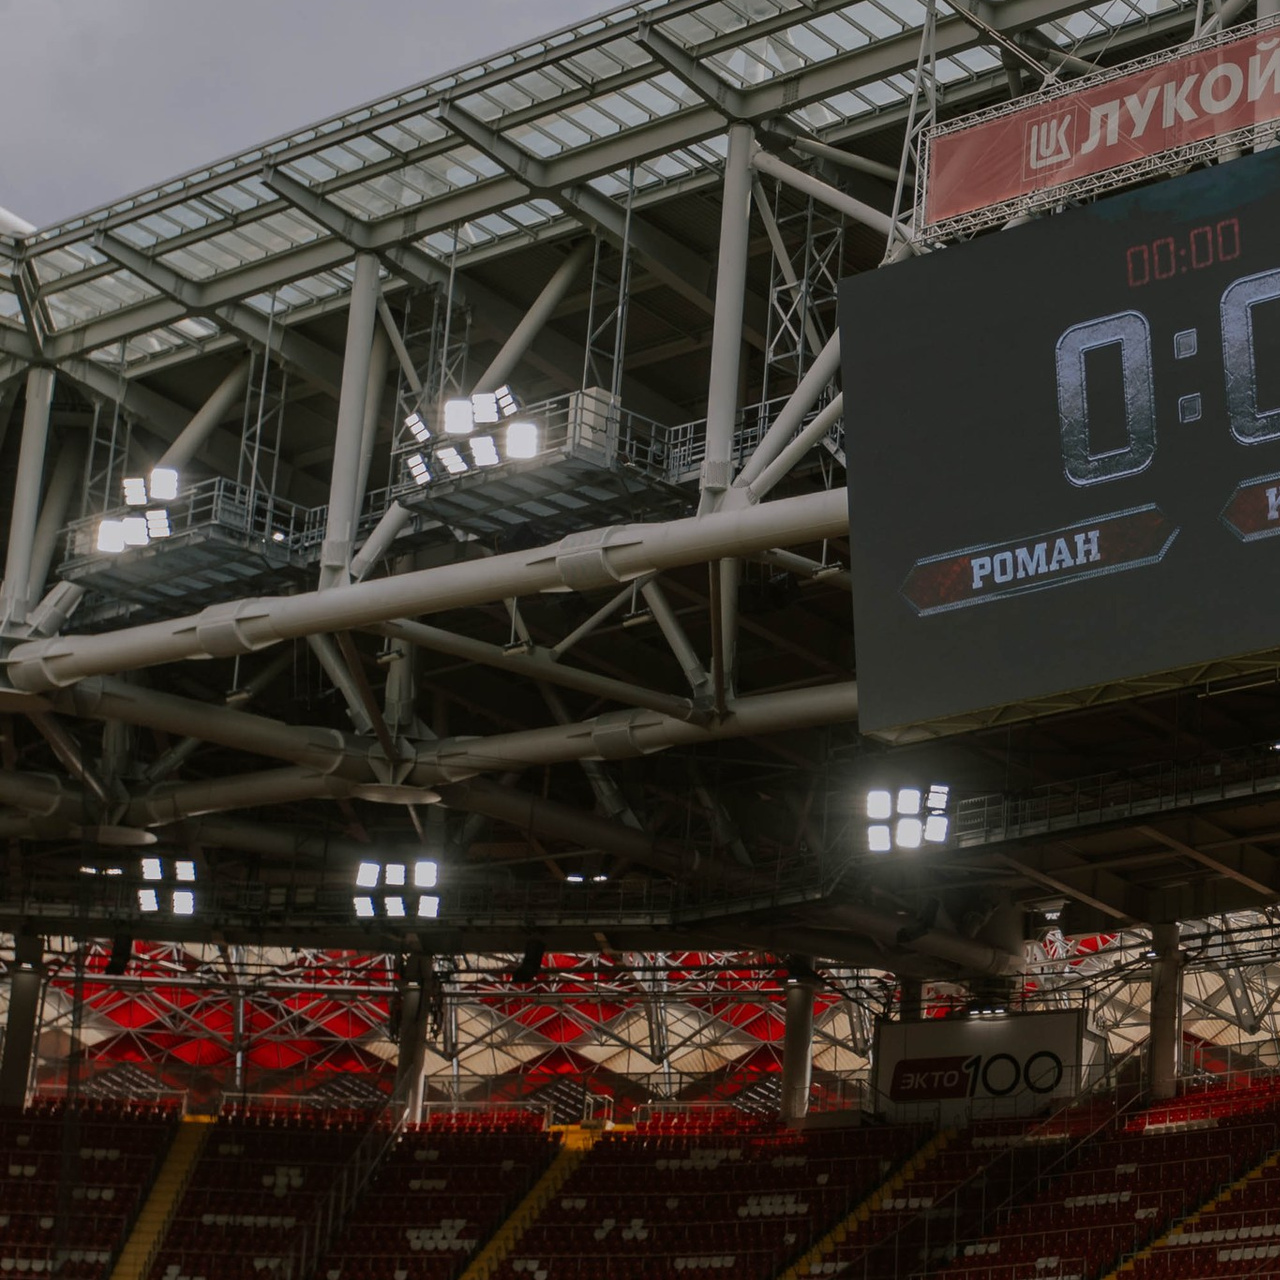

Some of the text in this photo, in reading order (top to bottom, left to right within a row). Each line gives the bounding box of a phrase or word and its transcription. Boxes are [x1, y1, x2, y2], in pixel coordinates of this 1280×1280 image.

[1126, 217, 1242, 287] 00:00
[970, 529, 1101, 590] РОМАН
[900, 1051, 1063, 1097] ЭКТО 100
